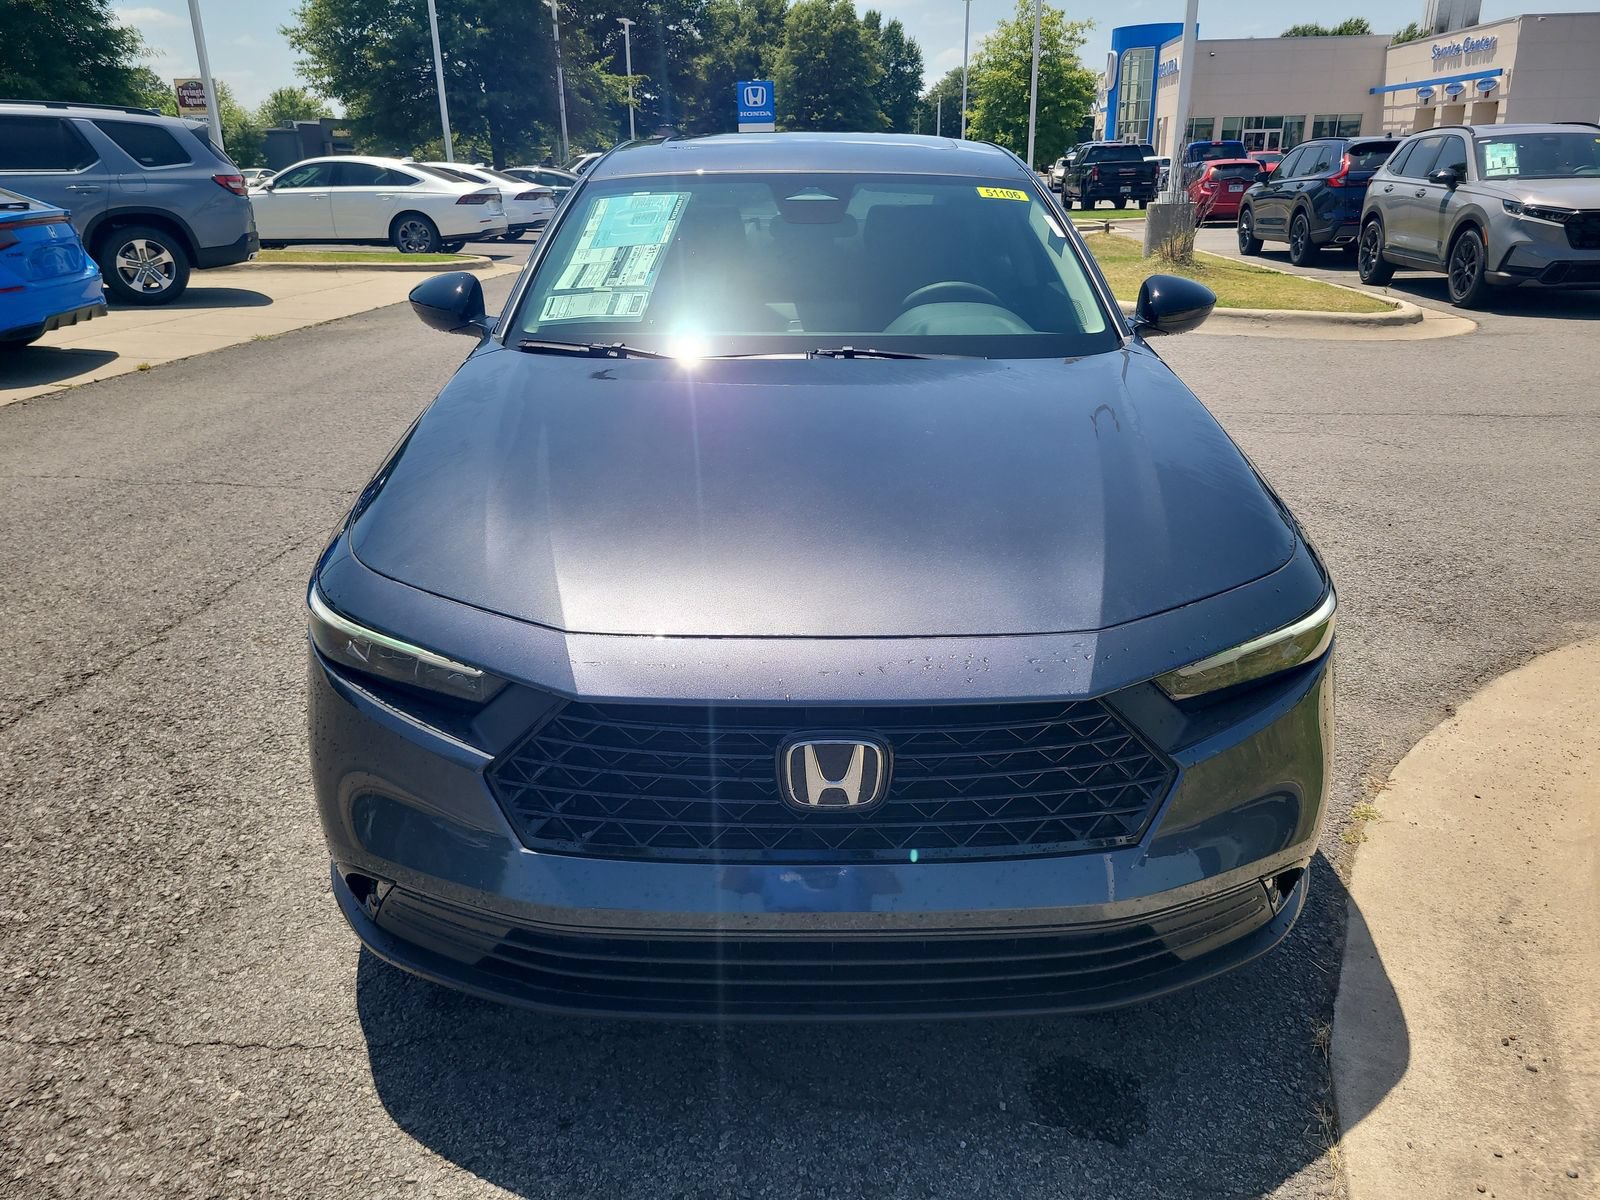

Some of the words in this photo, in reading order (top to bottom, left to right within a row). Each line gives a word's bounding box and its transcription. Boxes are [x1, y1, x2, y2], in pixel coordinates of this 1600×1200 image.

[1431, 41, 1463, 60] Service
[1463, 36, 1497, 54] Center
[985, 188, 1021, 199] 51106
